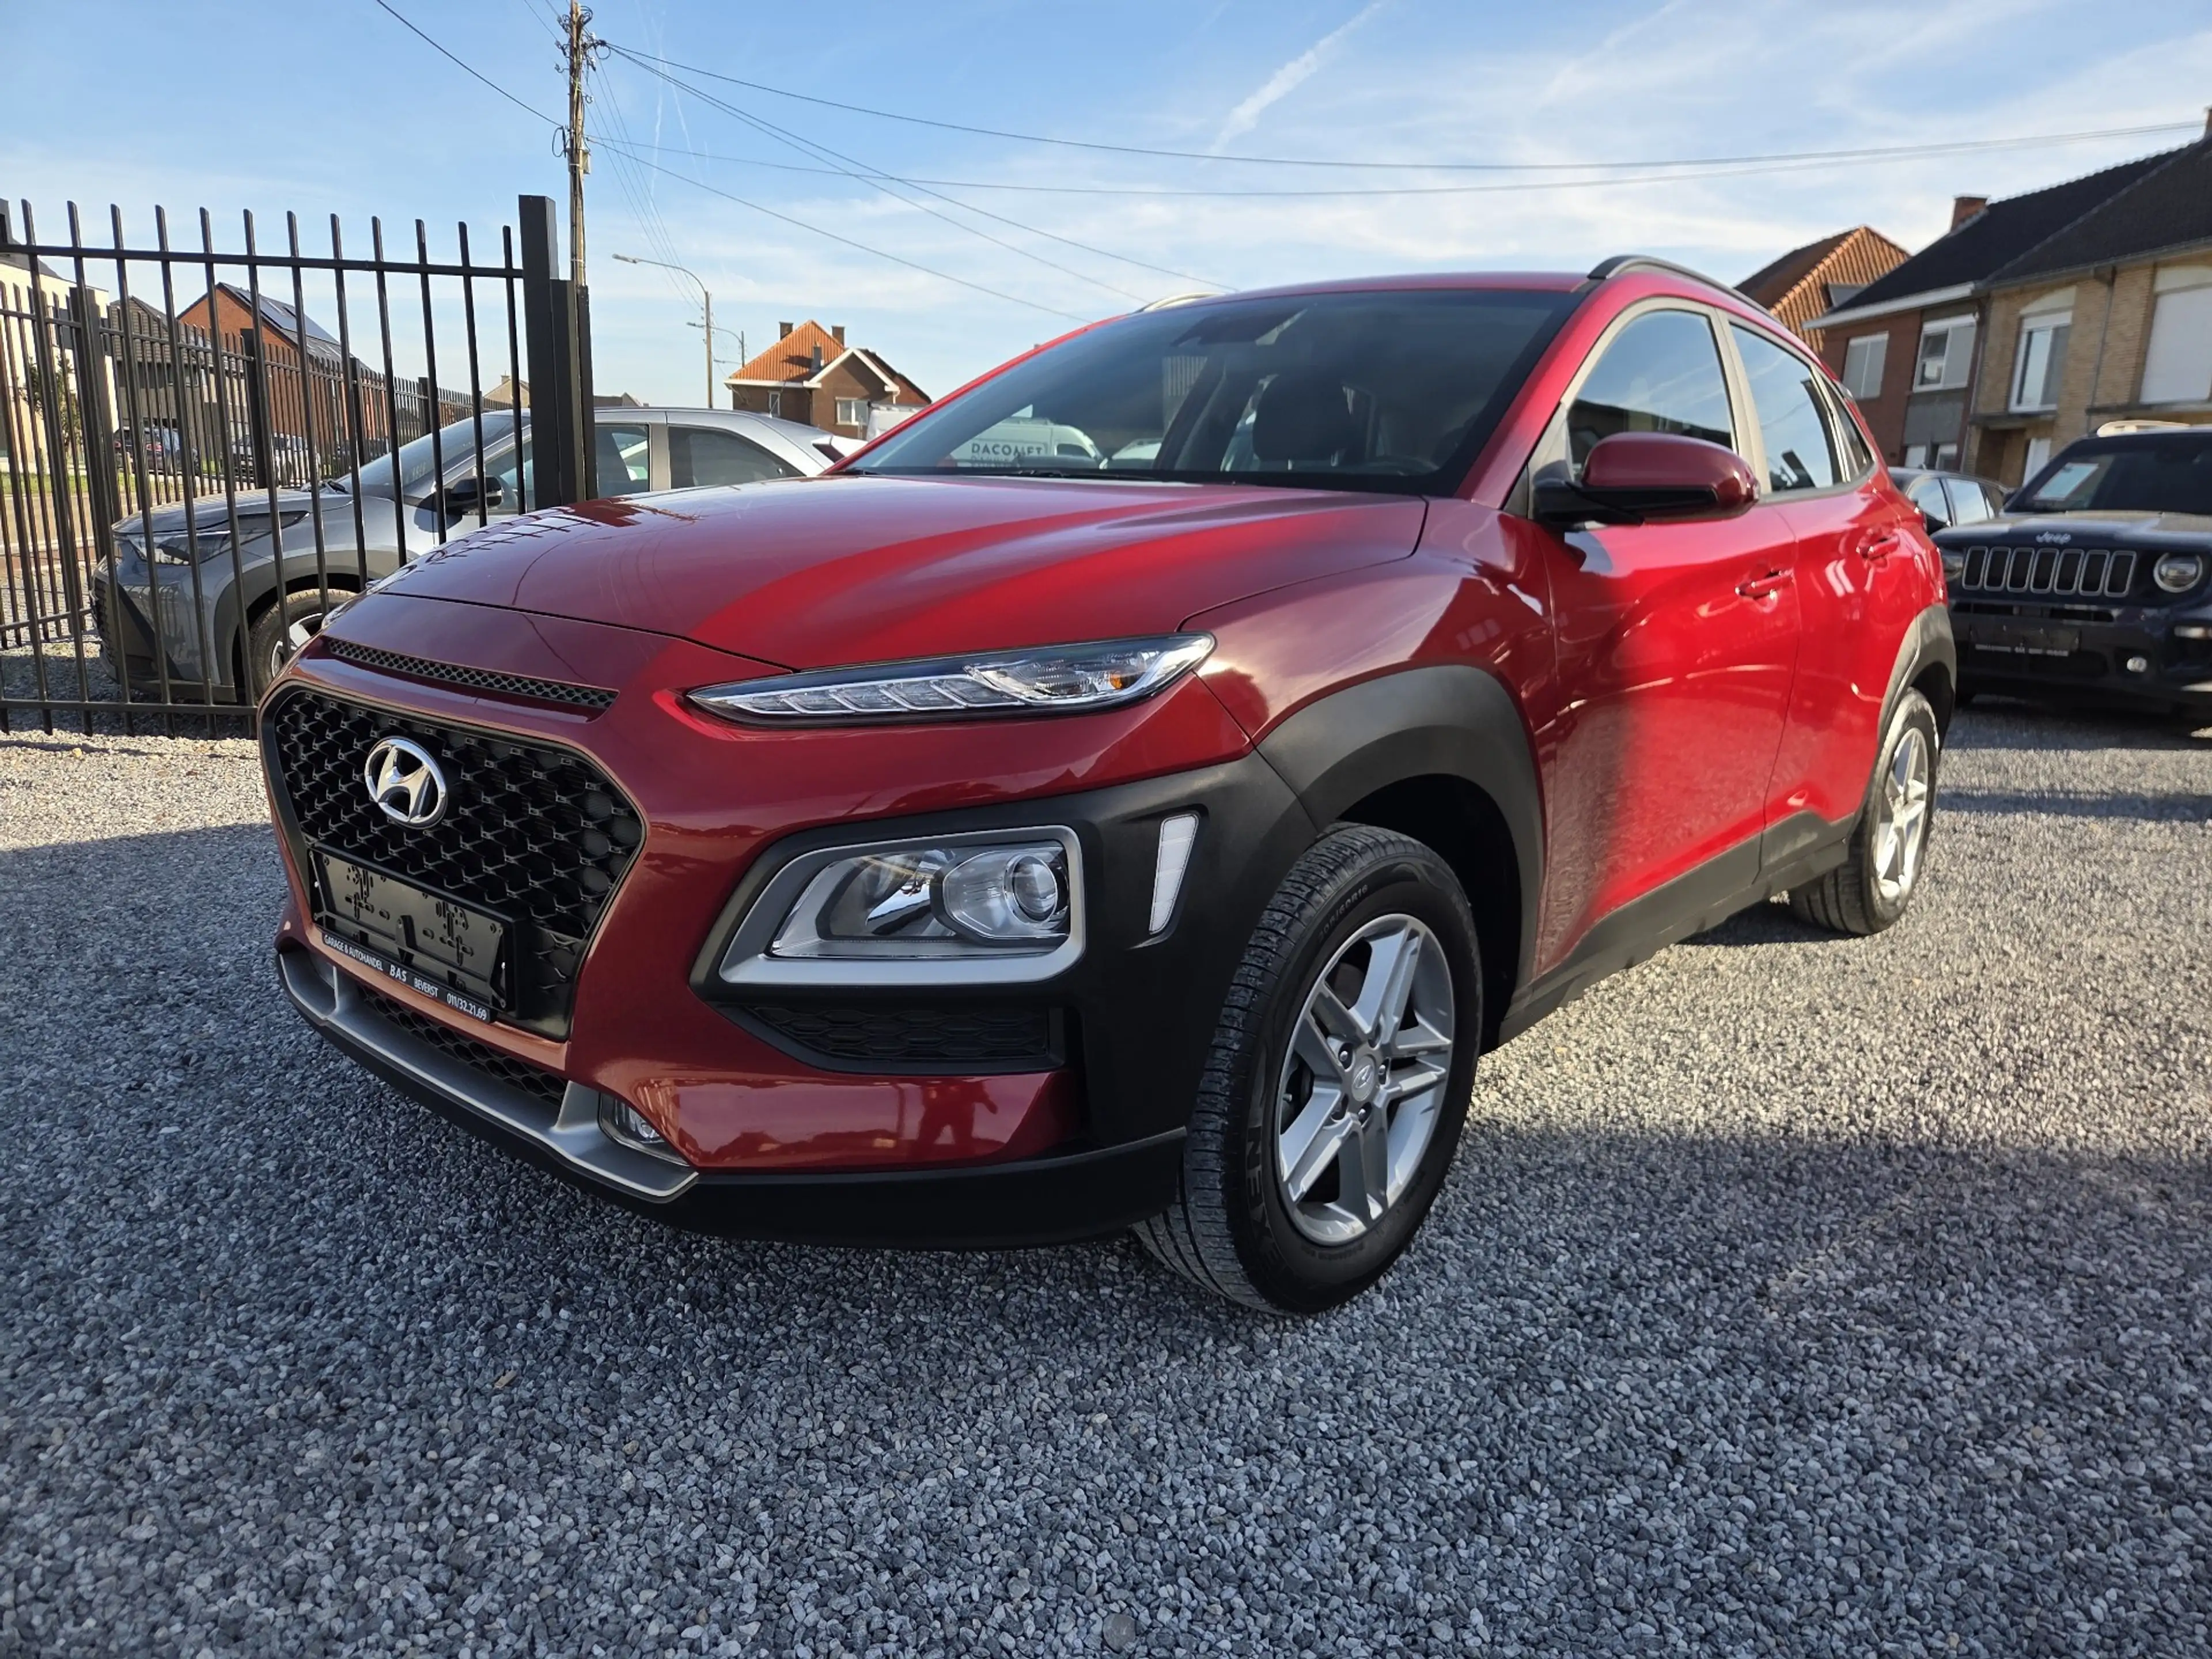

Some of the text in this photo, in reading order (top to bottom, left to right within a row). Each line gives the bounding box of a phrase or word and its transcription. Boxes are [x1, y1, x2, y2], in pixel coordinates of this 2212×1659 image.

[324, 934, 487, 1021] GARAGE & AUTOHANDEL BAS BEVERST 011/32.21.69
